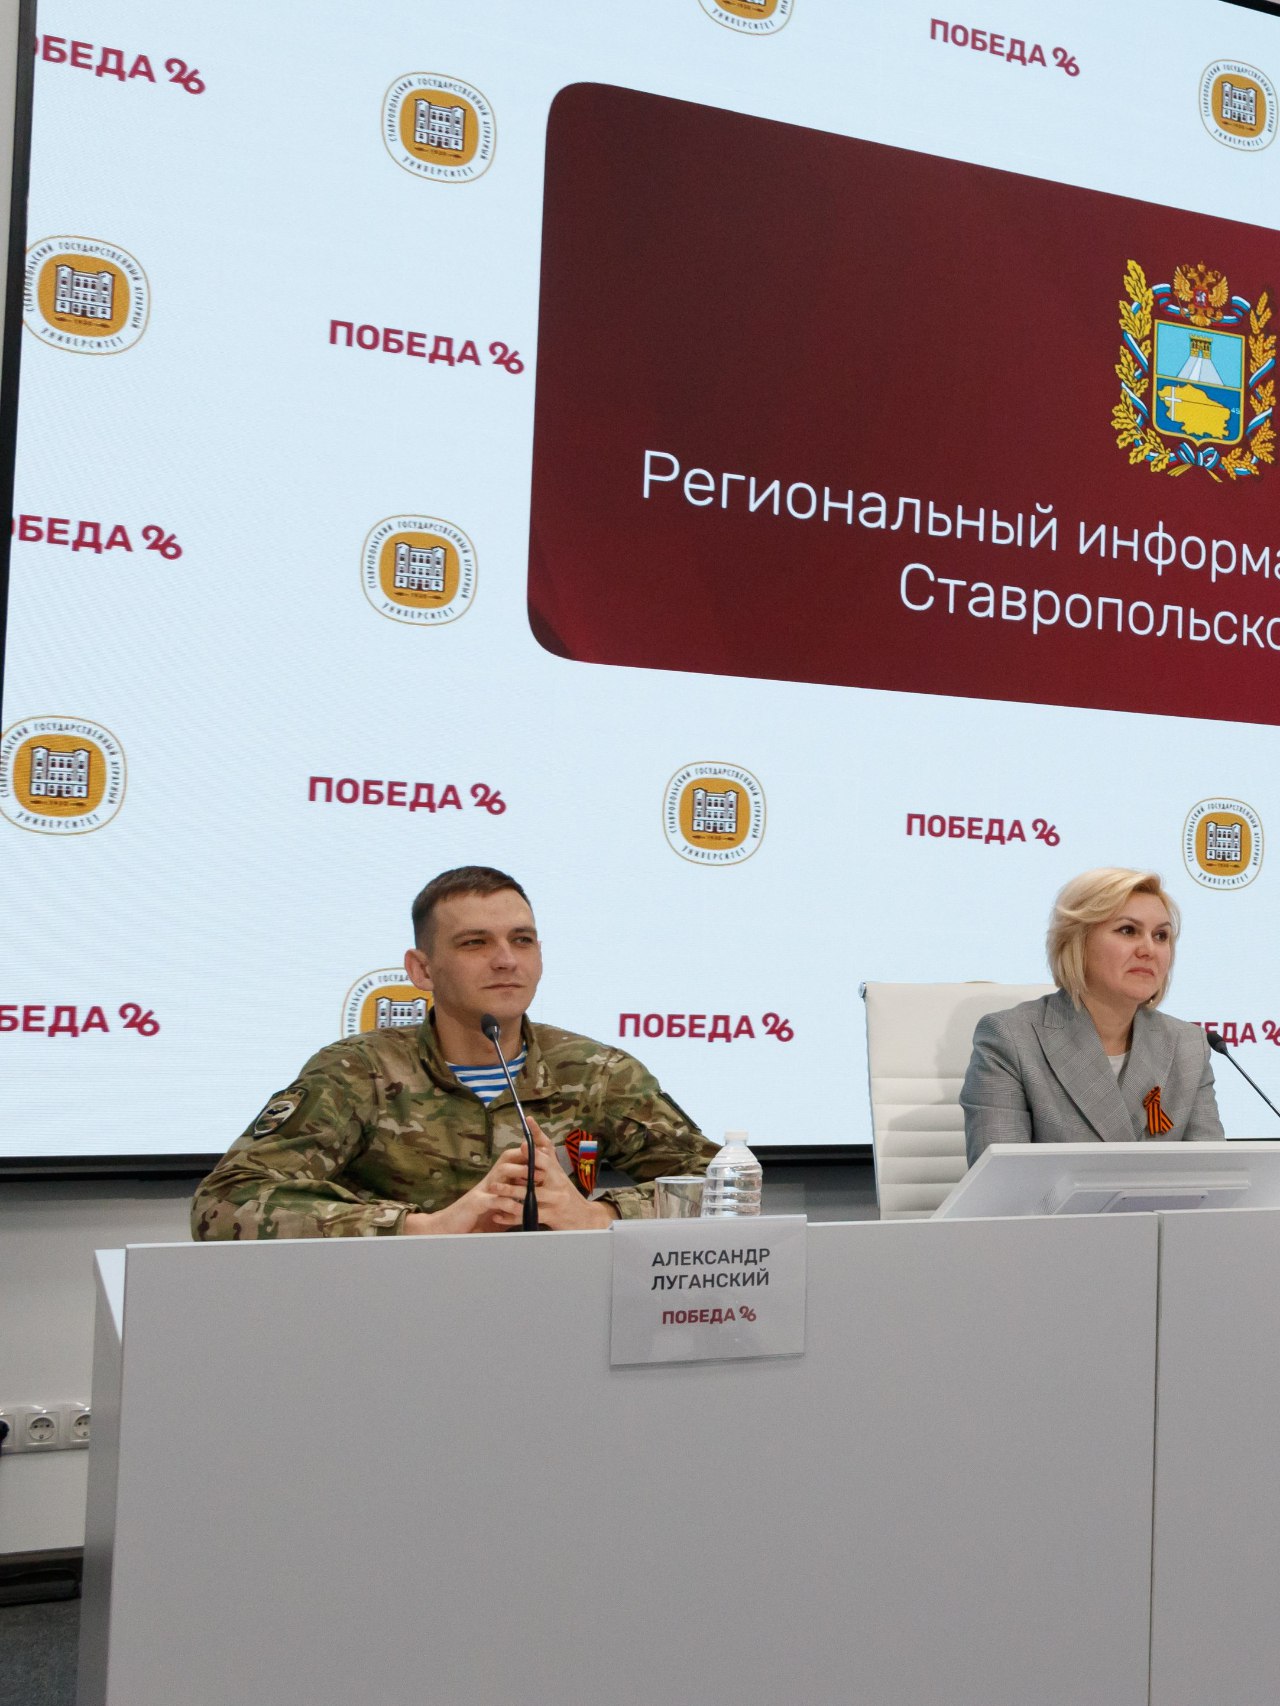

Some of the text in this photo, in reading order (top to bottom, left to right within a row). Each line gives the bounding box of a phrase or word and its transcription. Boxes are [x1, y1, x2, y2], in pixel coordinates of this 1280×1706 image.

[931, 19, 1045, 65] ПОБЕДА
[330, 320, 480, 366] ПОБЕДА
[643, 449, 1057, 551] Региональный
[309, 776, 462, 813] ПОБЕДА
[906, 813, 1026, 845] ПОБЕДА
[619, 1013, 755, 1043] ПОБЕДА
[1191, 1021, 1257, 1047] ЕДА
[652, 1248, 771, 1267] АЛЕКСАНДР
[651, 1267, 770, 1290] ЛУГАНСКИЙ
[662, 1308, 736, 1325] ПОБЕДА
